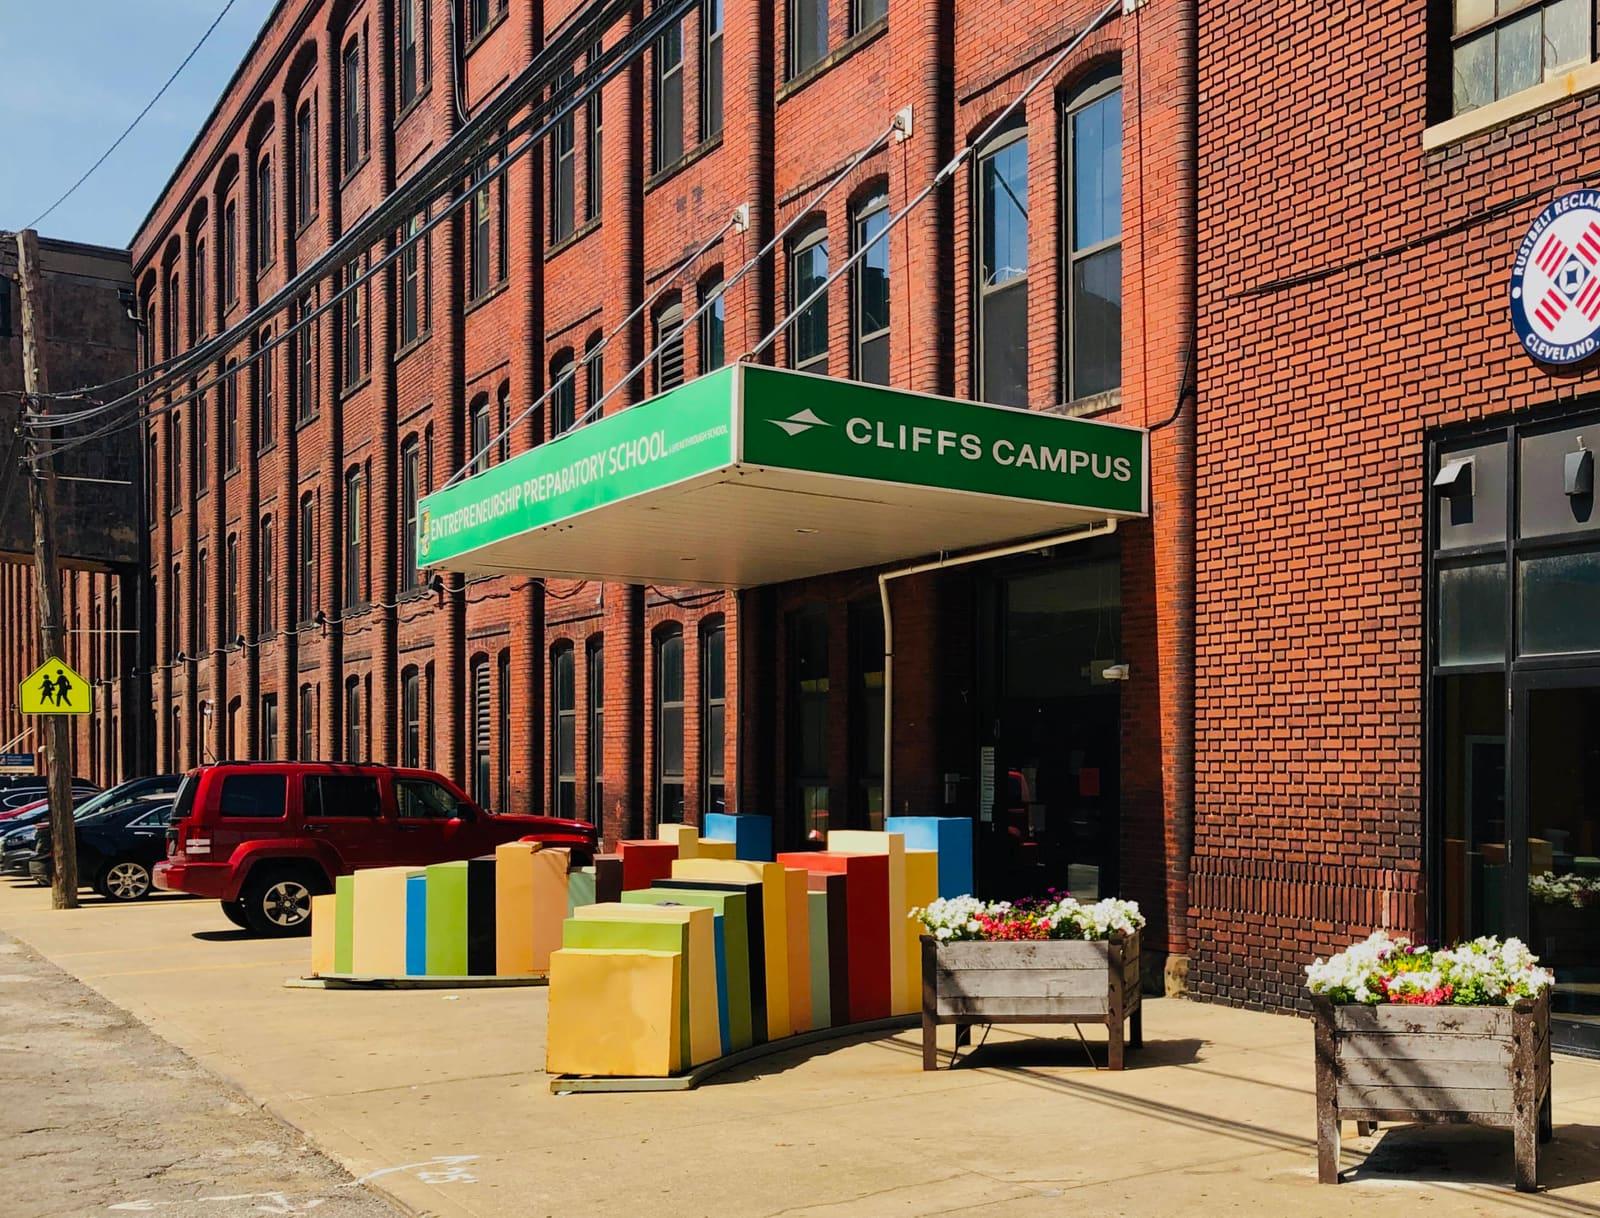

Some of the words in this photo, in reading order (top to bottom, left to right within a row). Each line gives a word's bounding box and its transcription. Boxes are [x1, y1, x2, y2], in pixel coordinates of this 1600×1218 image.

[1514, 209, 1552, 276] RUSTBELT
[846, 417, 982, 460] CLIFFS
[992, 439, 1132, 482] CAMPUS
[431, 484, 521, 541] ENTREPRENEURSHIP
[524, 450, 607, 507] PREPARATORY
[608, 429, 668, 475] SCHOOL
